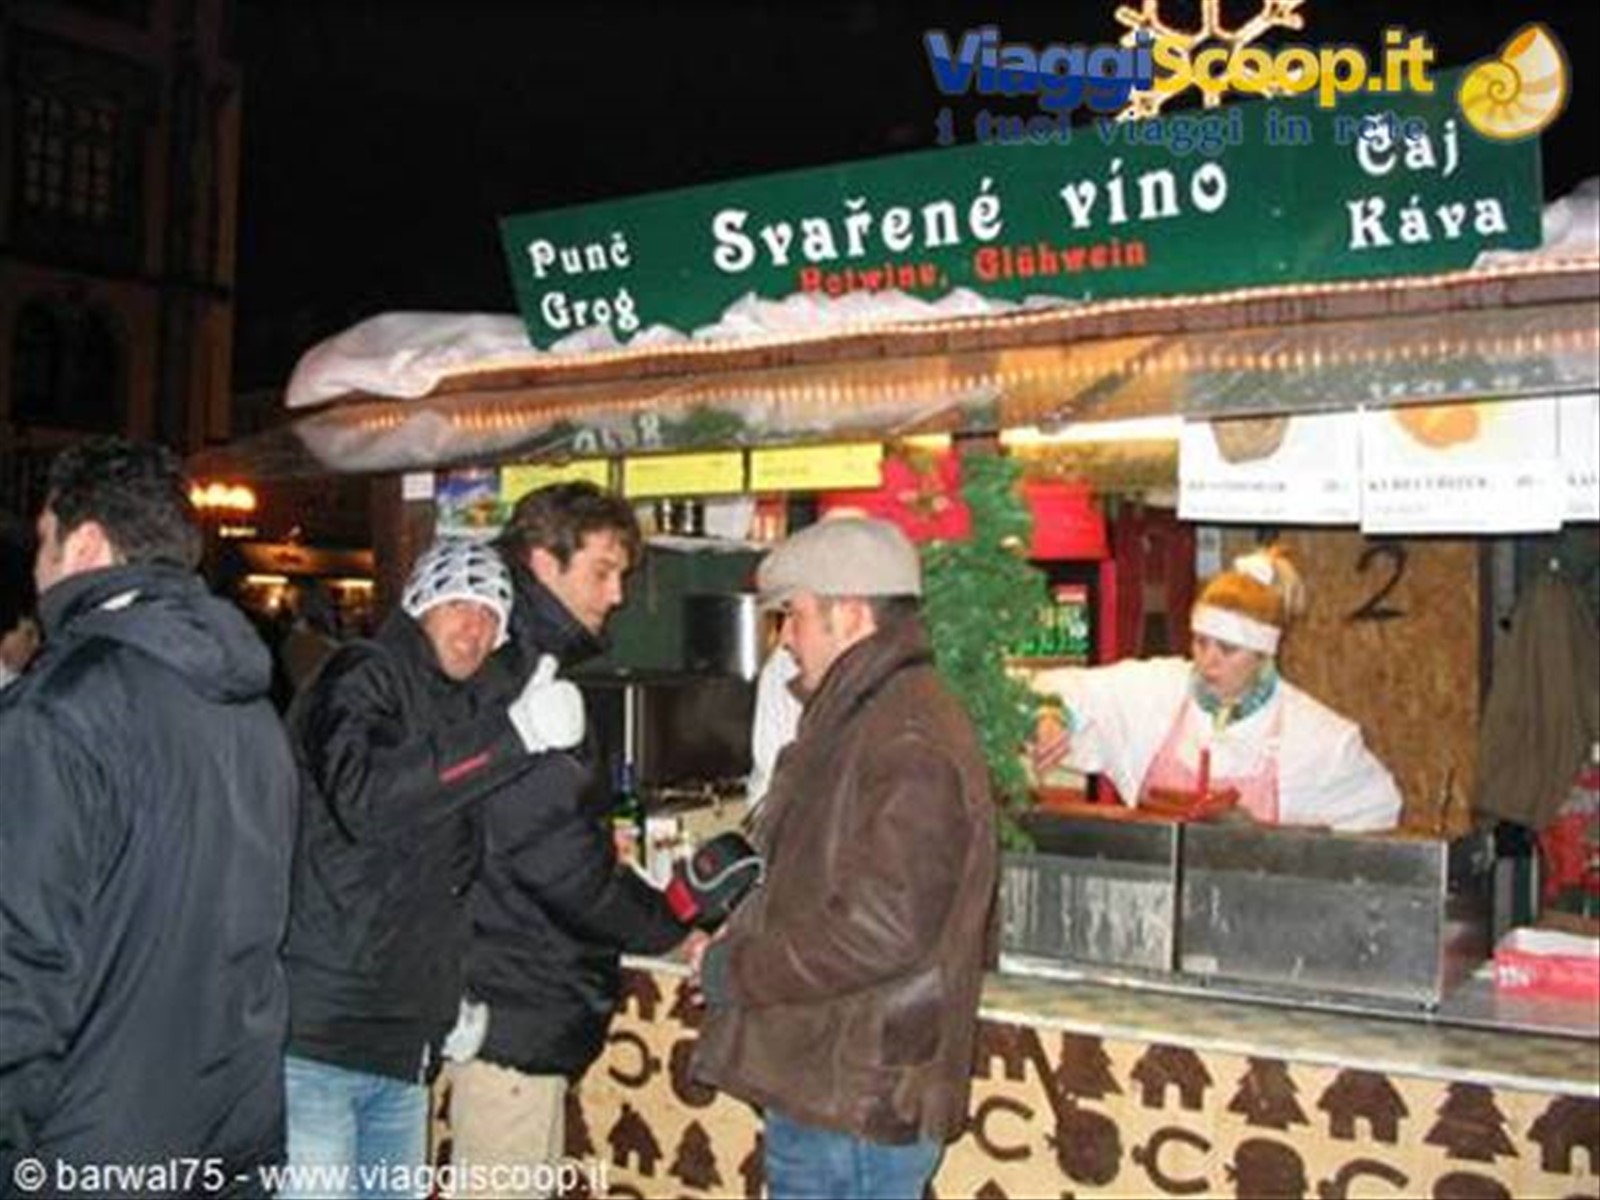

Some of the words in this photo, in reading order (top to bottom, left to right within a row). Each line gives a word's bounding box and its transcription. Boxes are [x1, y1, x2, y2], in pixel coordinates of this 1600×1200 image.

[1357, 112, 1459, 178] Čaj
[711, 176, 1004, 272] Svařené
[1060, 157, 1229, 229] víno
[1347, 194, 1509, 250] Káva
[528, 232, 632, 279] Punč
[974, 240, 1147, 284] Glühwein
[540, 287, 641, 333] Grog
[1350, 544, 1406, 622] 2
